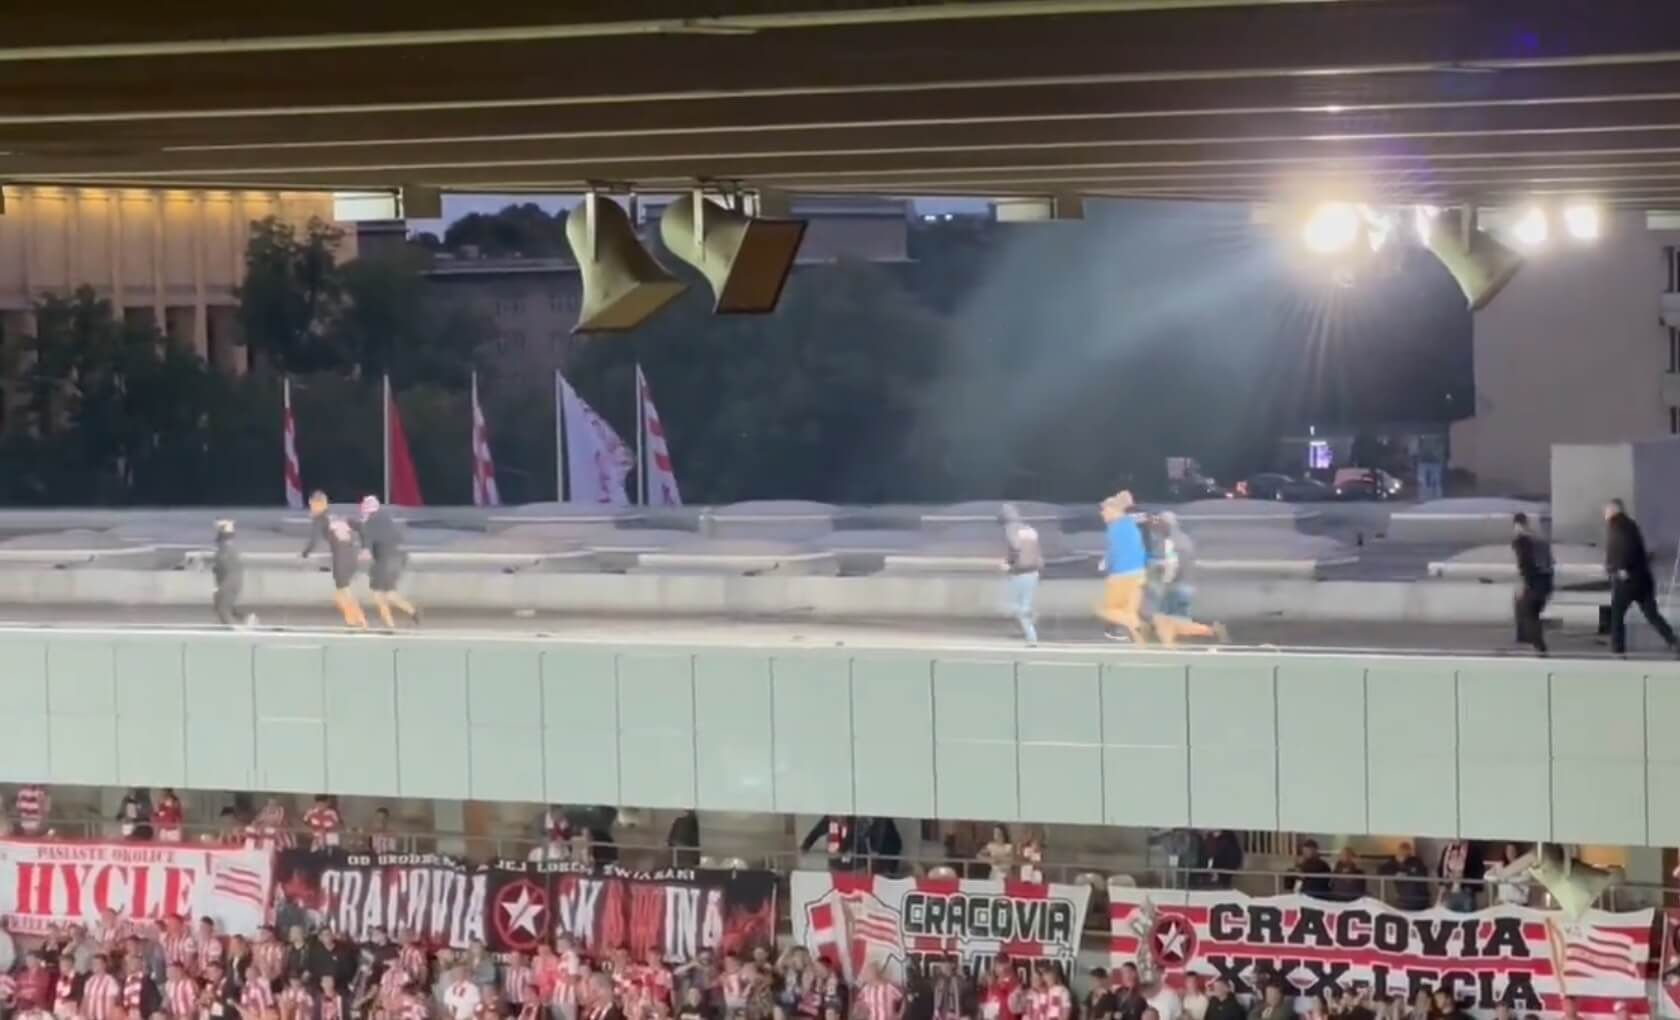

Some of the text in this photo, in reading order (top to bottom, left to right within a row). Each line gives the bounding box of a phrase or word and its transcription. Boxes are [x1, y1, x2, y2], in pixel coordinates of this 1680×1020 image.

[37, 846, 176, 864] PASIASTE OKOLICE
[347, 854, 371, 866] OD
[16, 862, 196, 920] HYCLE
[320, 868, 489, 949] CRACOVIA
[903, 892, 1073, 944] CRACOVIA
[1208, 902, 1531, 957] CRACOVIA
